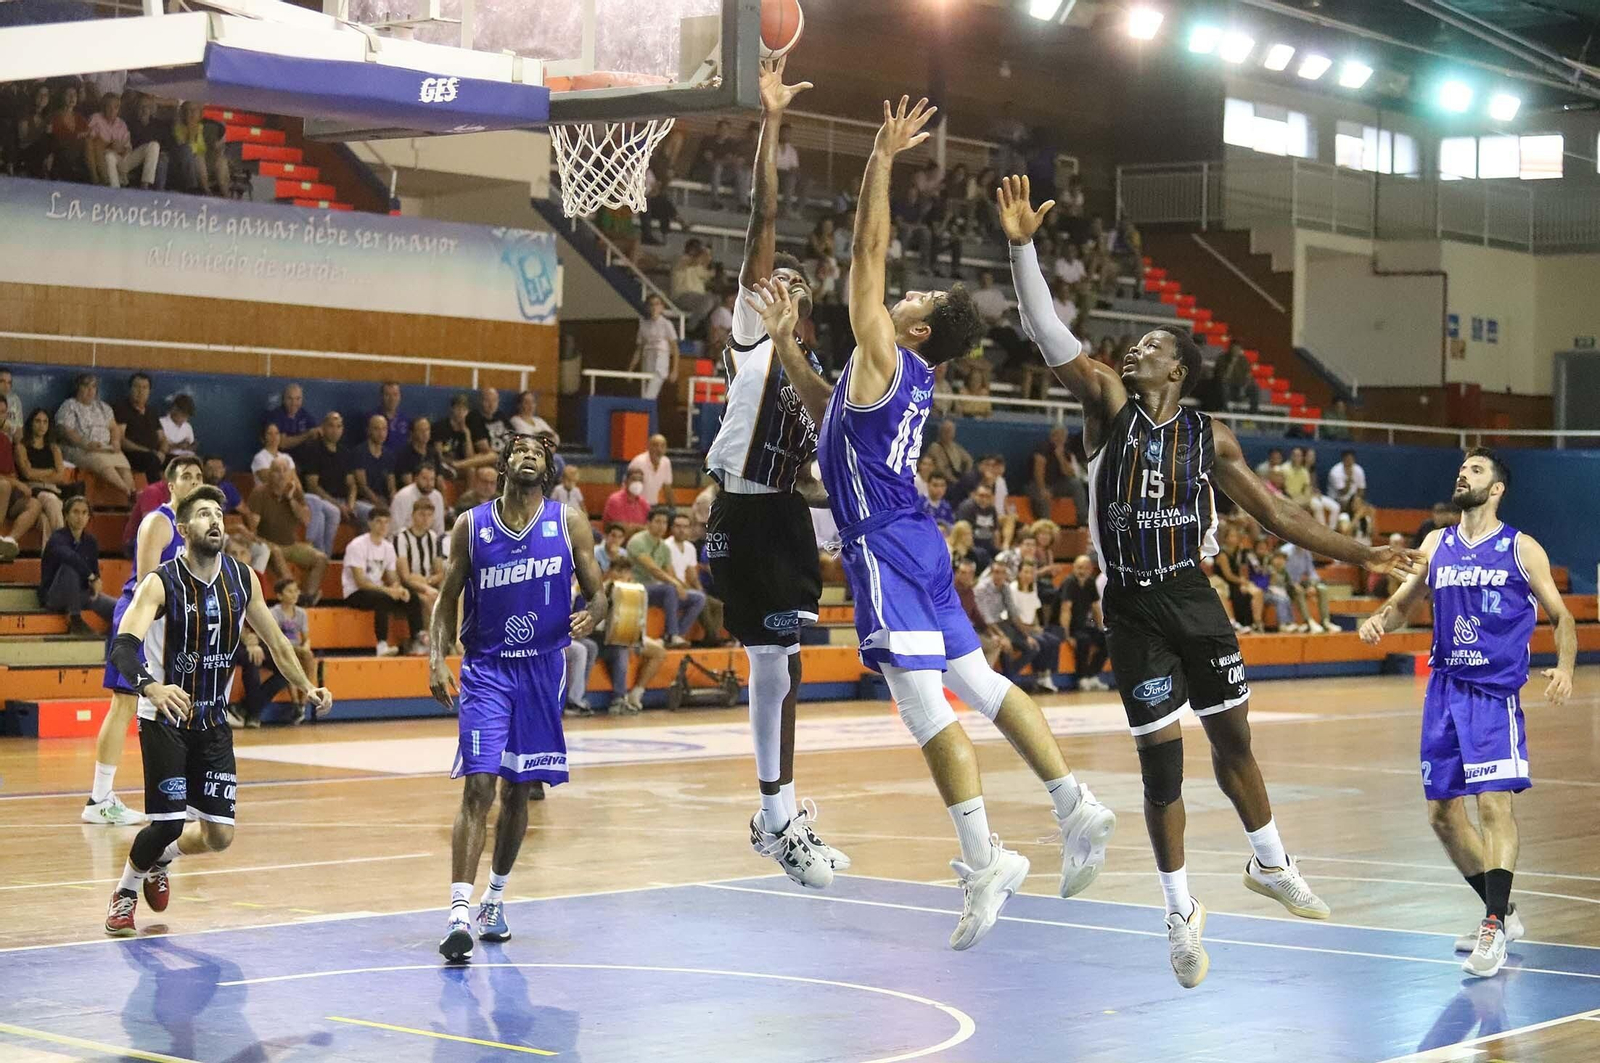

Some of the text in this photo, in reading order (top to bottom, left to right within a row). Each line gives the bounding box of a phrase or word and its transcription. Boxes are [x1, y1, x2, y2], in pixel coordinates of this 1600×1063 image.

[419, 77, 460, 103] GES
[46, 192, 459, 265] La emoción de ganar debe ser mayor
[1140, 469, 1165, 498] 15
[1137, 508, 1181, 520] HUELVA
[1137, 514, 1197, 529] TE SALUDA
[480, 556, 562, 590] Huelva
[1435, 565, 1508, 589] Huelva
[544, 581, 551, 606] 1
[1482, 589, 1501, 614] 12
[207, 623, 221, 646] 7
[203, 653, 231, 663] HUELV
[214, 661, 232, 669] SAL
[500, 649, 538, 659] HUELVA
[1143, 680, 1169, 697] Ford
[471, 730, 480, 756] 1
[523, 755, 566, 769] Huelva
[1422, 761, 1432, 785] 2
[1465, 764, 1497, 779] uelva
[224, 784, 236, 801] OR
